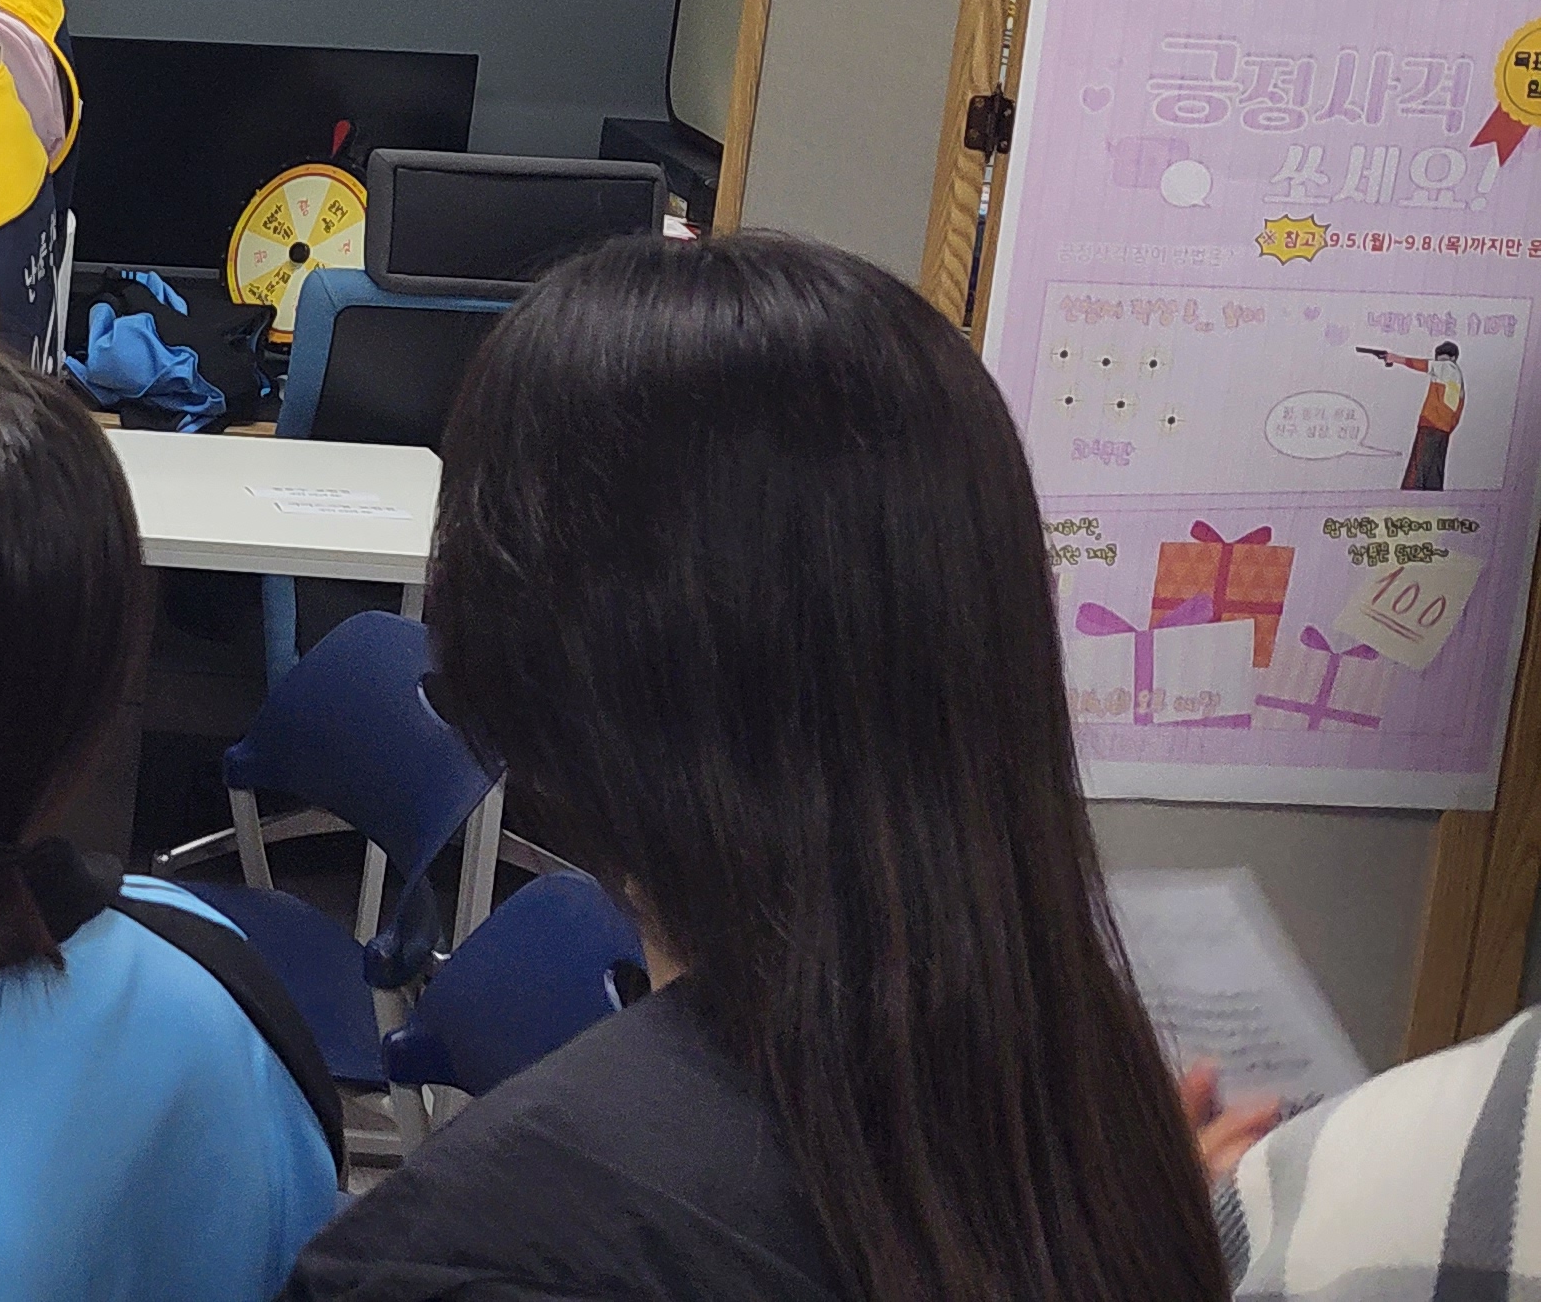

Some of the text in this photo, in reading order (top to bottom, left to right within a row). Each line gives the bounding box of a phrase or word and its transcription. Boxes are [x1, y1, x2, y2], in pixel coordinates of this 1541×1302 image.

[1146, 35, 1475, 136] 긍정사격
[1263, 145, 1499, 212] 쏘세요!
[1284, 230, 1317, 249] 참고
[1371, 565, 1447, 628] 100
